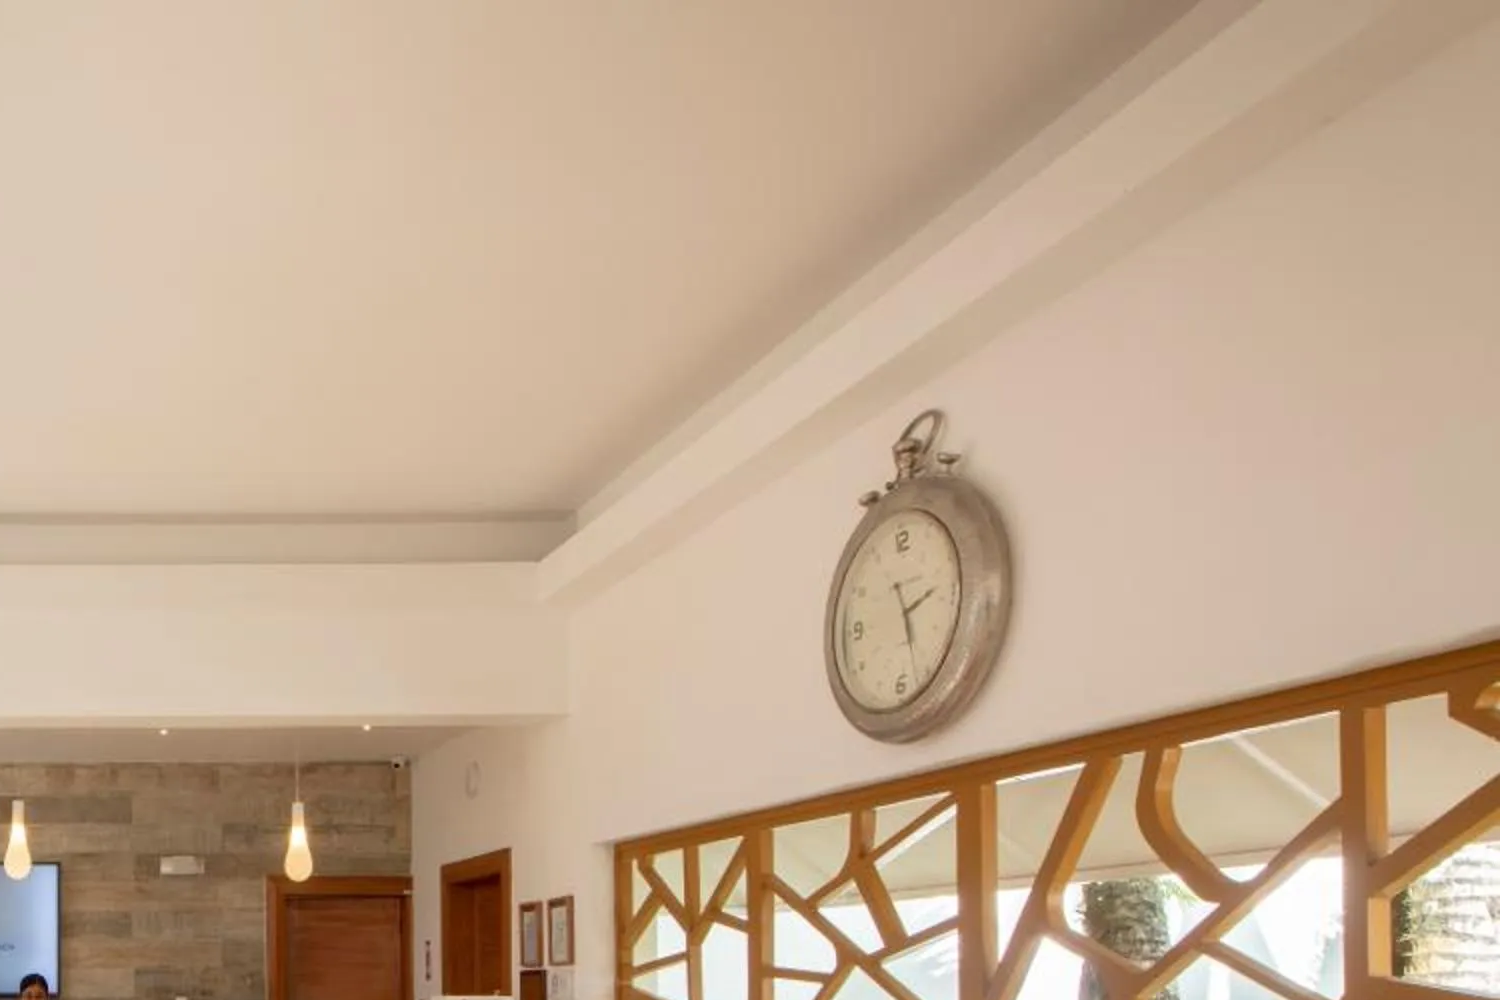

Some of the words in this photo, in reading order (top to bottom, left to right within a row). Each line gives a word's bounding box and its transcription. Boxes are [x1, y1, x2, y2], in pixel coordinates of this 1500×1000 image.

[895, 530, 910, 553] 12
[853, 621, 864, 641] 9
[895, 674, 907, 695] 6
